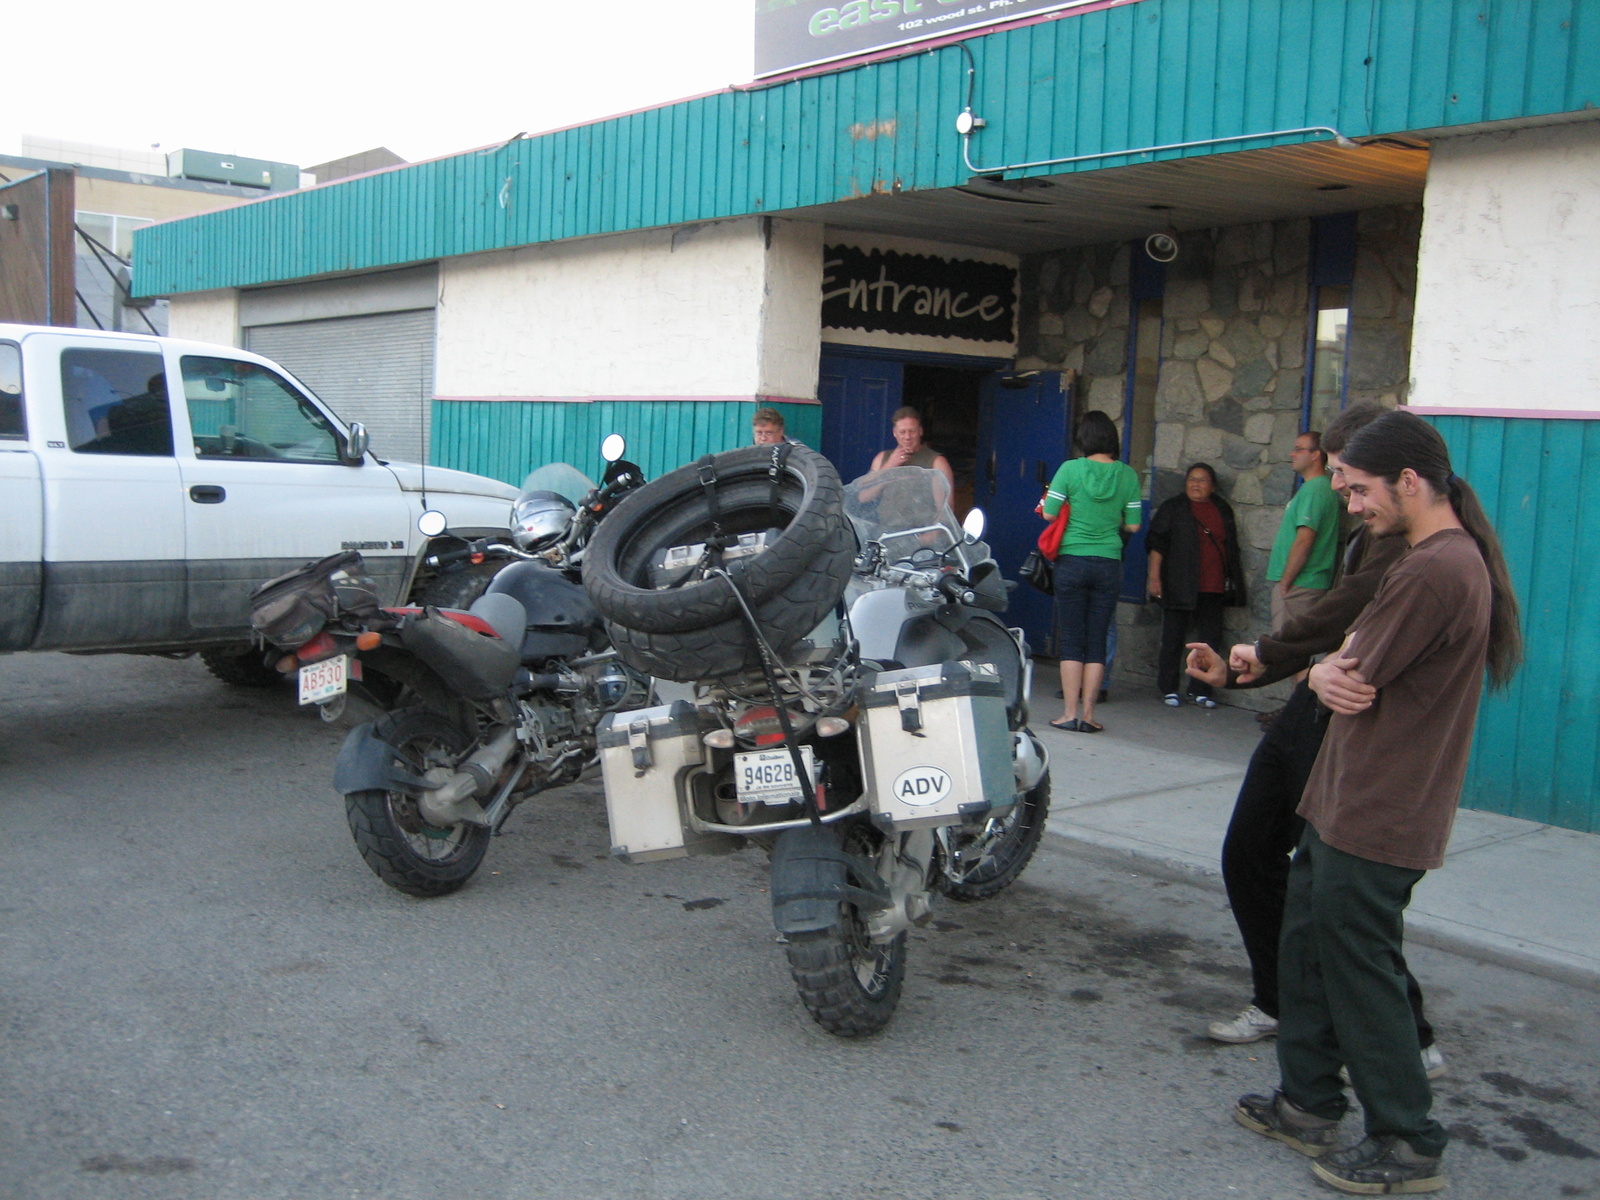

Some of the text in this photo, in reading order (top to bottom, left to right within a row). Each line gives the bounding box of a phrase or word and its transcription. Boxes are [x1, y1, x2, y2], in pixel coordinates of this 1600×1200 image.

[897, 18, 923, 31] 102
[926, 9, 965, 25] wood
[967, 4, 986, 15] st.
[822, 259, 1004, 321] Entrance
[303, 665, 342, 692] AB530
[744, 763, 798, 785] 94628
[901, 775, 944, 797] ADV
